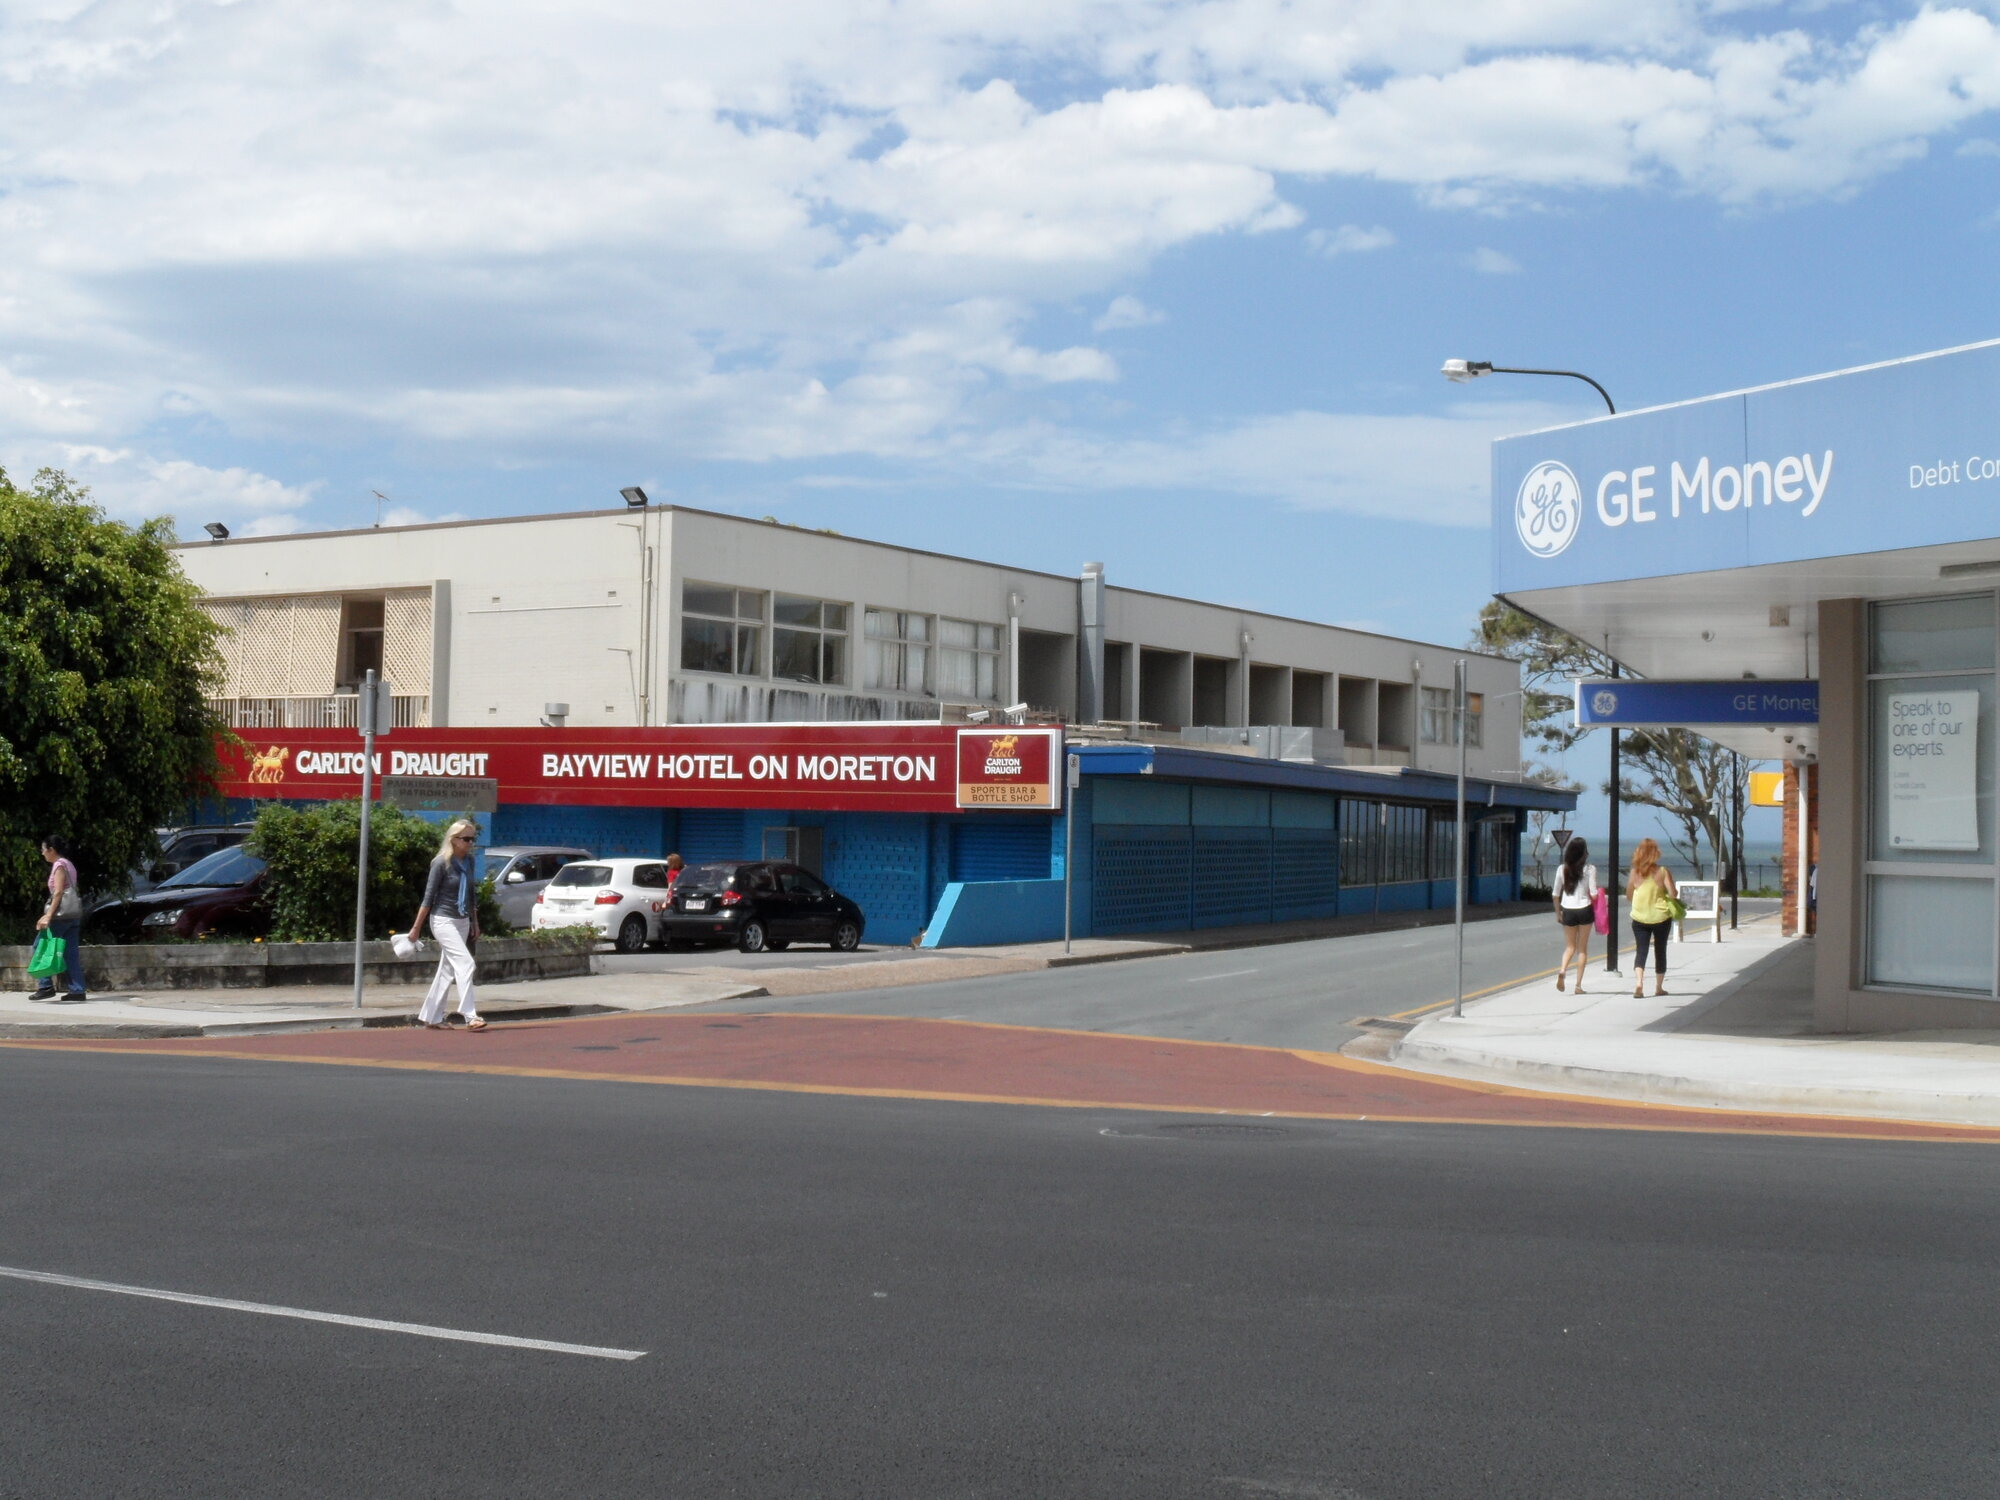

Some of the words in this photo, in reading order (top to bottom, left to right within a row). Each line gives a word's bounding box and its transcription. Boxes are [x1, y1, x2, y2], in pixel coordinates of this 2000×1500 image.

[1910, 459, 1960, 488] Debt
[1597, 466, 1656, 526] GE
[1671, 450, 1833, 518] Money
[1733, 694, 1757, 711] GE
[1762, 694, 1819, 714] Money
[1892, 698, 1934, 720] Speak
[1937, 700, 1952, 716] to
[1893, 723, 1918, 737] one
[1922, 718, 1936, 736] of
[1939, 722, 1963, 735] our
[1893, 741, 1945, 760] experts.
[295, 750, 382, 775] CARLTON
[391, 751, 489, 776] DRAUGHT
[542, 754, 651, 778] BAYVIEW
[657, 755, 743, 779] HOTEL
[749, 755, 788, 780] ON
[796, 755, 936, 782] MORETON
[984, 766, 1022, 774] DRAUGHT
[986, 758, 1020, 766] CARLTON
[970, 786, 1007, 794] SPORTS
[1009, 786, 1028, 794] BAR
[1030, 786, 1036, 794] &
[972, 794, 1008, 802] BOTTLE
[1010, 794, 1036, 802] SHOP
